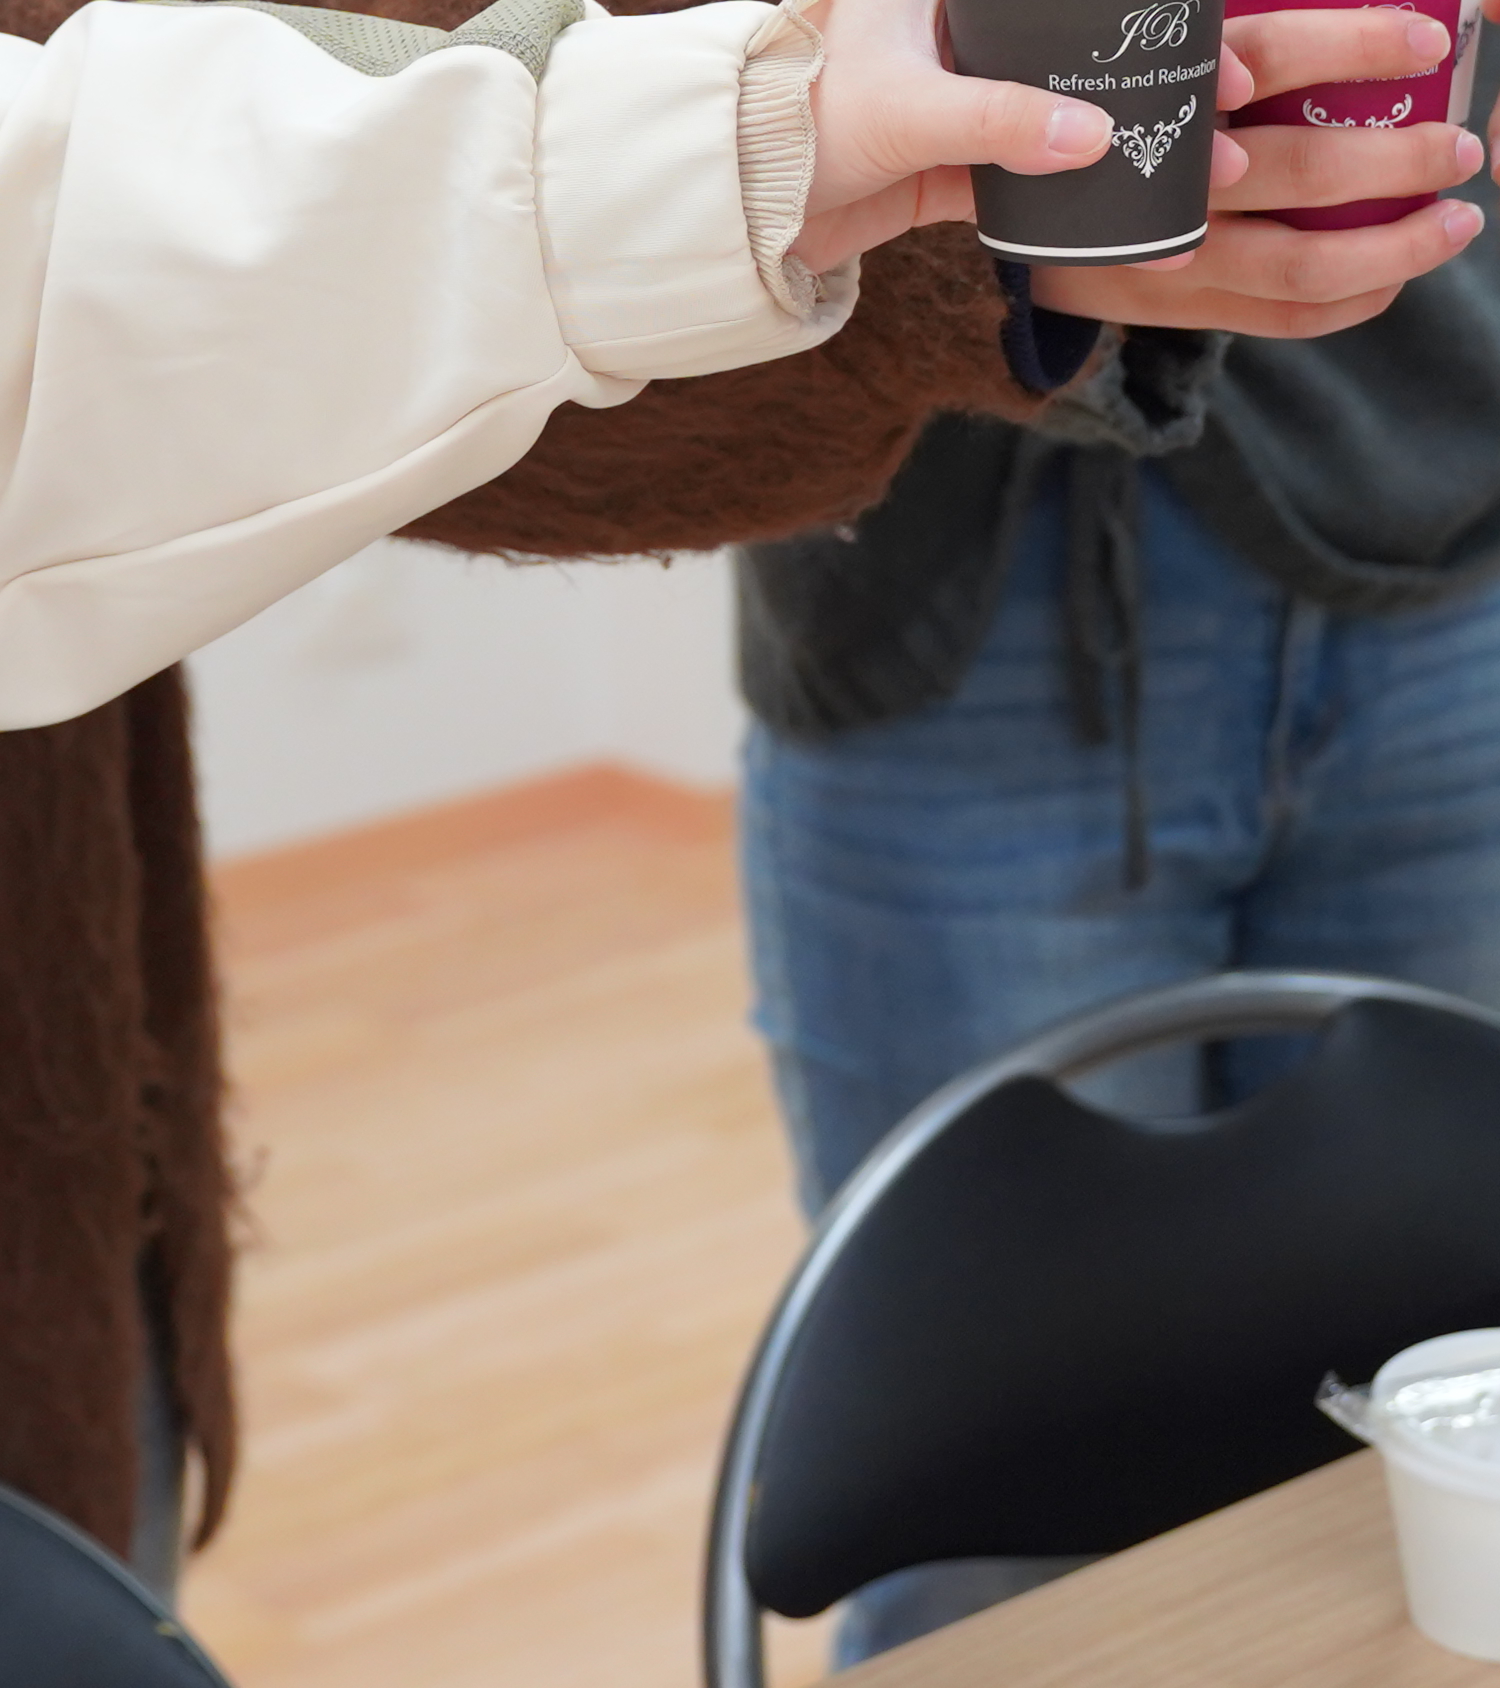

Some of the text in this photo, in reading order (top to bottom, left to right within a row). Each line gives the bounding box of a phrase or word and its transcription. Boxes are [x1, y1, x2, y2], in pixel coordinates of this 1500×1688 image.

[1048, 57, 1218, 92] Refresh and Relaxation
